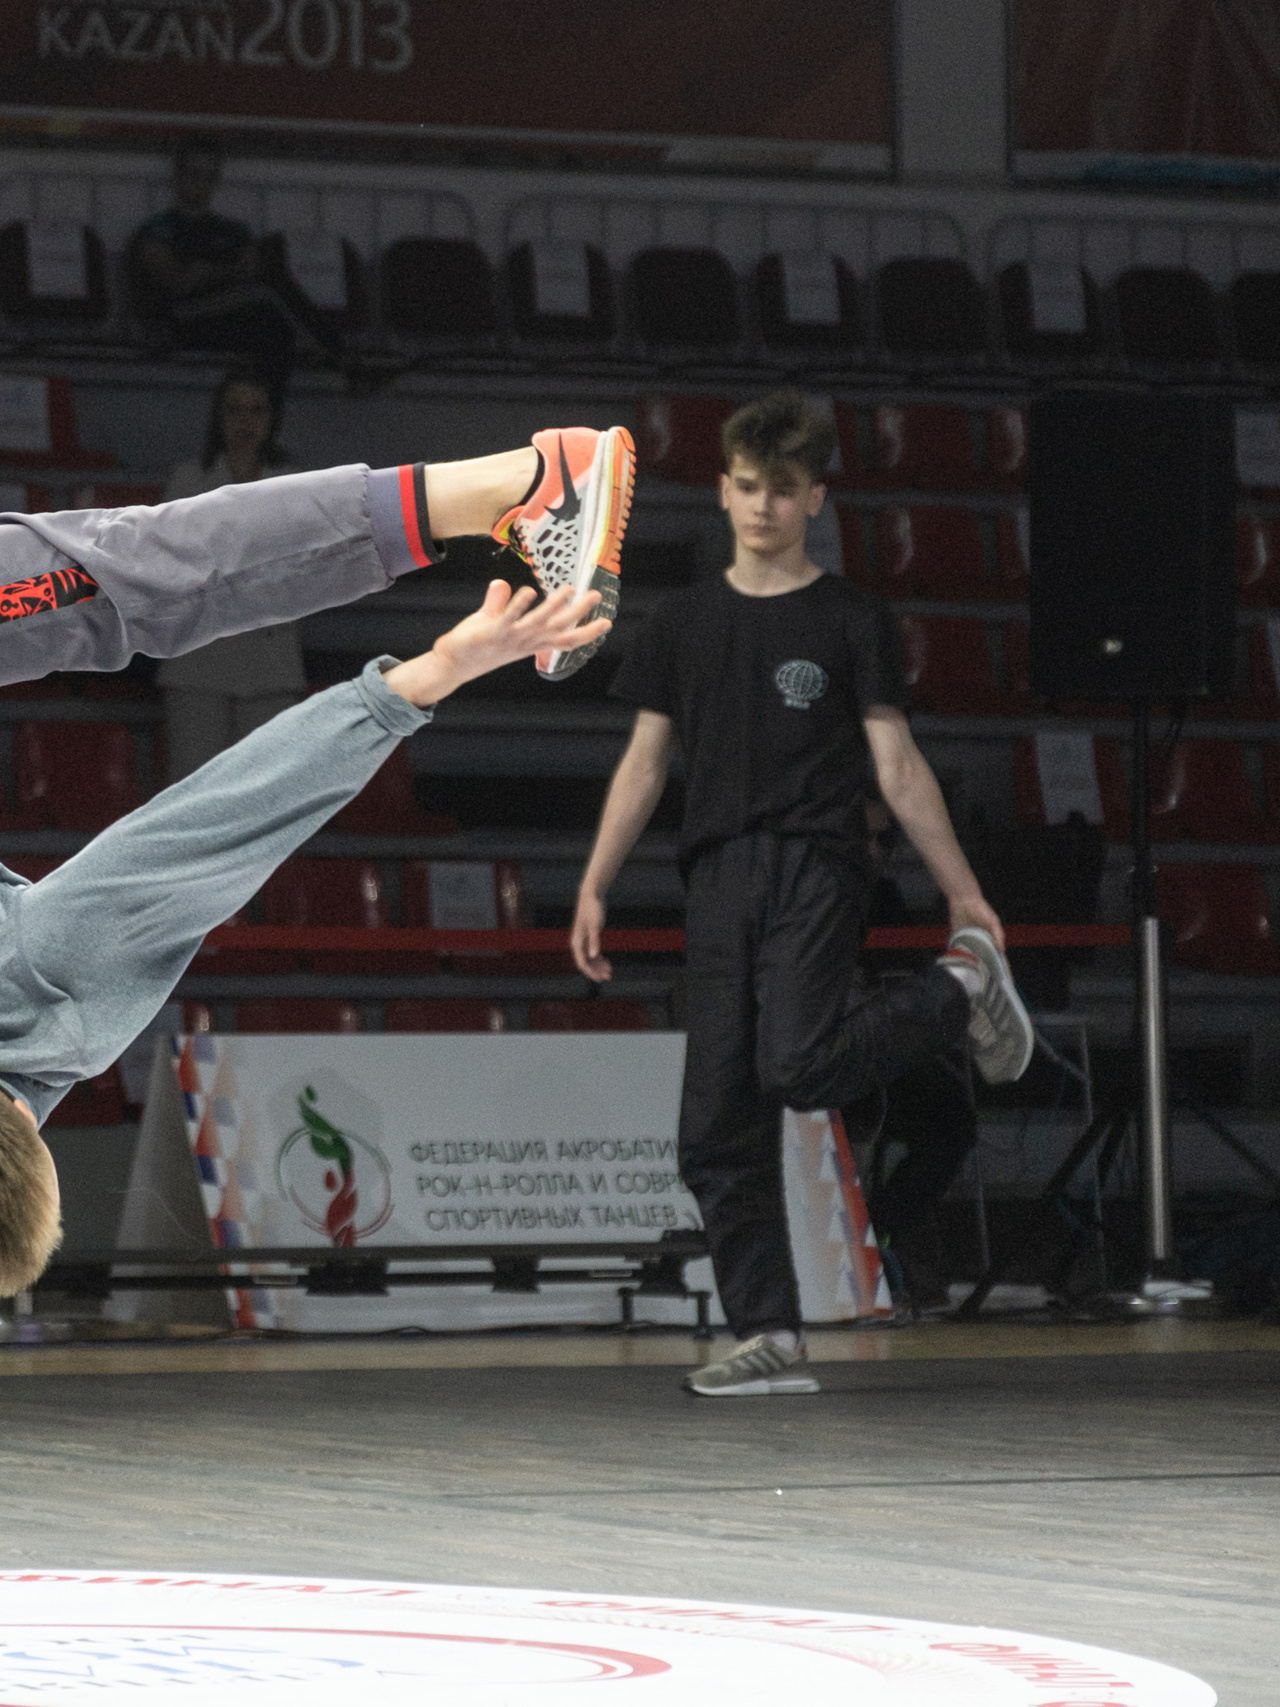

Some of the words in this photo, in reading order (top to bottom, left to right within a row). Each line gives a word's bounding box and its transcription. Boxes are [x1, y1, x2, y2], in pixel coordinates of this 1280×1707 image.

[410, 1140, 549, 1164] ФЕДЕРАЦИЯ
[417, 1173, 584, 1197] РОК-Н-РОЛЛА
[587, 1173, 608, 1194] И
[426, 1207, 584, 1231] СПОРТИВНЫХ
[586, 1206, 678, 1229] ТАНЦЕВ
[533, 1600, 904, 1633] ФИНАЛ
[929, 1642, 1136, 1689] ФИНАЛ
